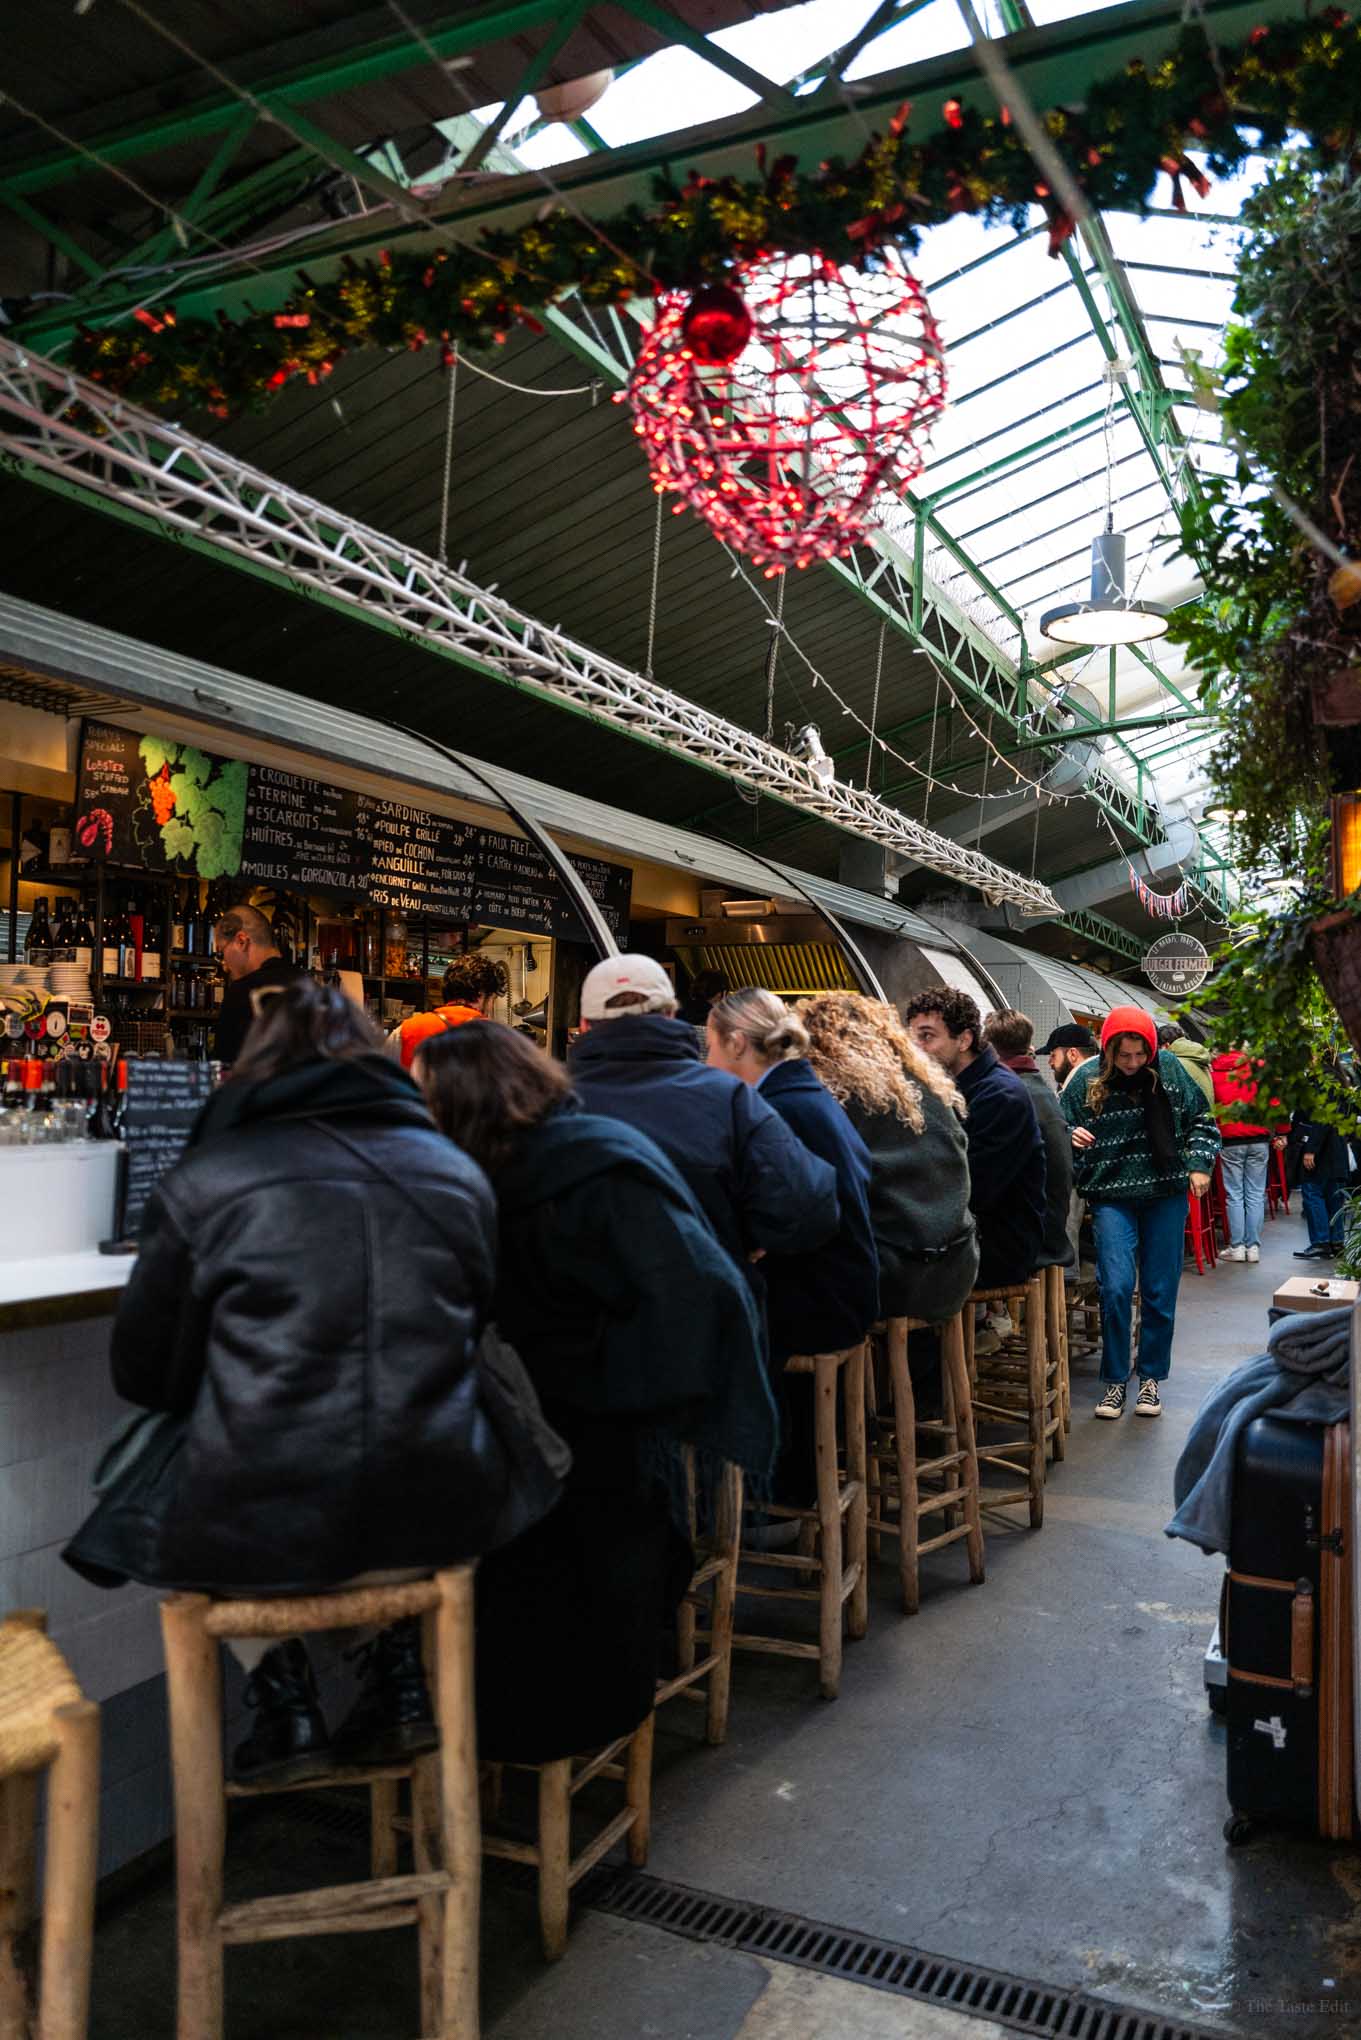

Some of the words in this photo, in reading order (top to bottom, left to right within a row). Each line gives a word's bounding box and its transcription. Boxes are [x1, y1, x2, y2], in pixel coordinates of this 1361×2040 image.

[86, 758, 124, 773] LOBSTER
[260, 767, 320, 794] CROQUETTE
[257, 785, 305, 809] TERRINE
[255, 806, 320, 831] ESCARGOTS
[381, 801, 432, 828] SARDINES
[380, 819, 411, 838] POULPE
[403, 842, 435, 862] COCHON
[488, 835, 508, 850] FAUX
[510, 839, 529, 857] FILET
[247, 863, 288, 880] MOULES
[301, 867, 356, 889] GORGONZOLA
[375, 873, 411, 889] ENCORNET
[400, 892, 421, 911] VEAU
[1143, 959, 1173, 970] BURGER
[1175, 959, 1211, 970] FERMIER
